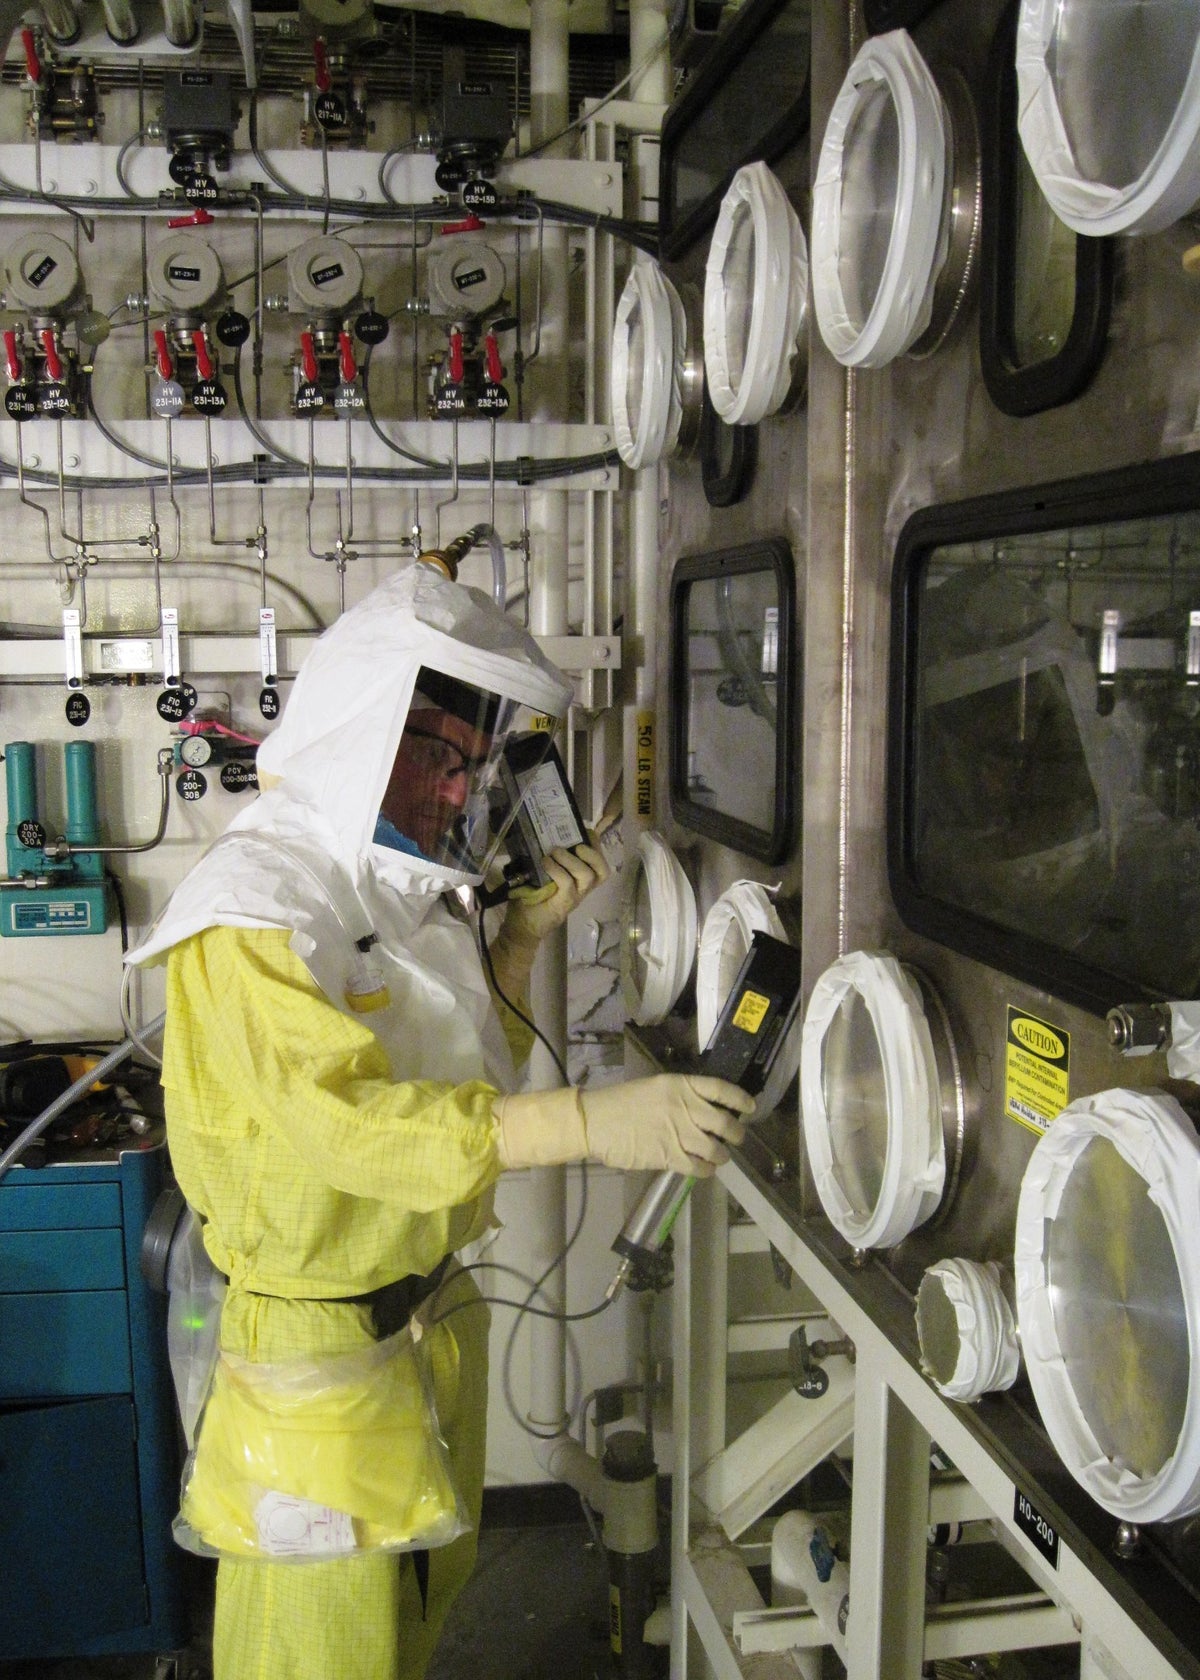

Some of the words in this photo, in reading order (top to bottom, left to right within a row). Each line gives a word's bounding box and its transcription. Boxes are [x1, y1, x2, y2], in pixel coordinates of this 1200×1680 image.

[324, 101, 336, 110] HV
[195, 179, 207, 188] HV
[186, 189, 217, 198] 231-13B
[474, 186, 486, 194] HV
[465, 194, 495, 204] 232-13B
[49, 389, 61, 398] HV
[162, 387, 174, 395] HV
[203, 386, 215, 395] HV
[305, 387, 316, 397] HV
[343, 388, 355, 397] HV
[445, 390, 457, 399] HV
[486, 388, 499, 398] HV
[15, 392, 27, 401] HV
[193, 396, 225, 406] 231-13A
[42, 399, 71, 409] 231-12A
[155, 397, 183, 407] 231-11A
[334, 398, 365, 408] 232-12A
[437, 399, 465, 409] 232-11A
[477, 399, 509, 408] 232-13A
[167, 696, 181, 707] FIC
[264, 695, 273, 704] FIC
[72, 701, 83, 710] FIC
[159, 703, 183, 717] 231-13
[639, 725, 652, 748] 50
[227, 766, 241, 775] PCV
[638, 778, 651, 815] STEAM
[23, 823, 39, 832] DRY
[1017, 1023, 1059, 1055] CAUTION
[1019, 1494, 1054, 1547] HO-200
